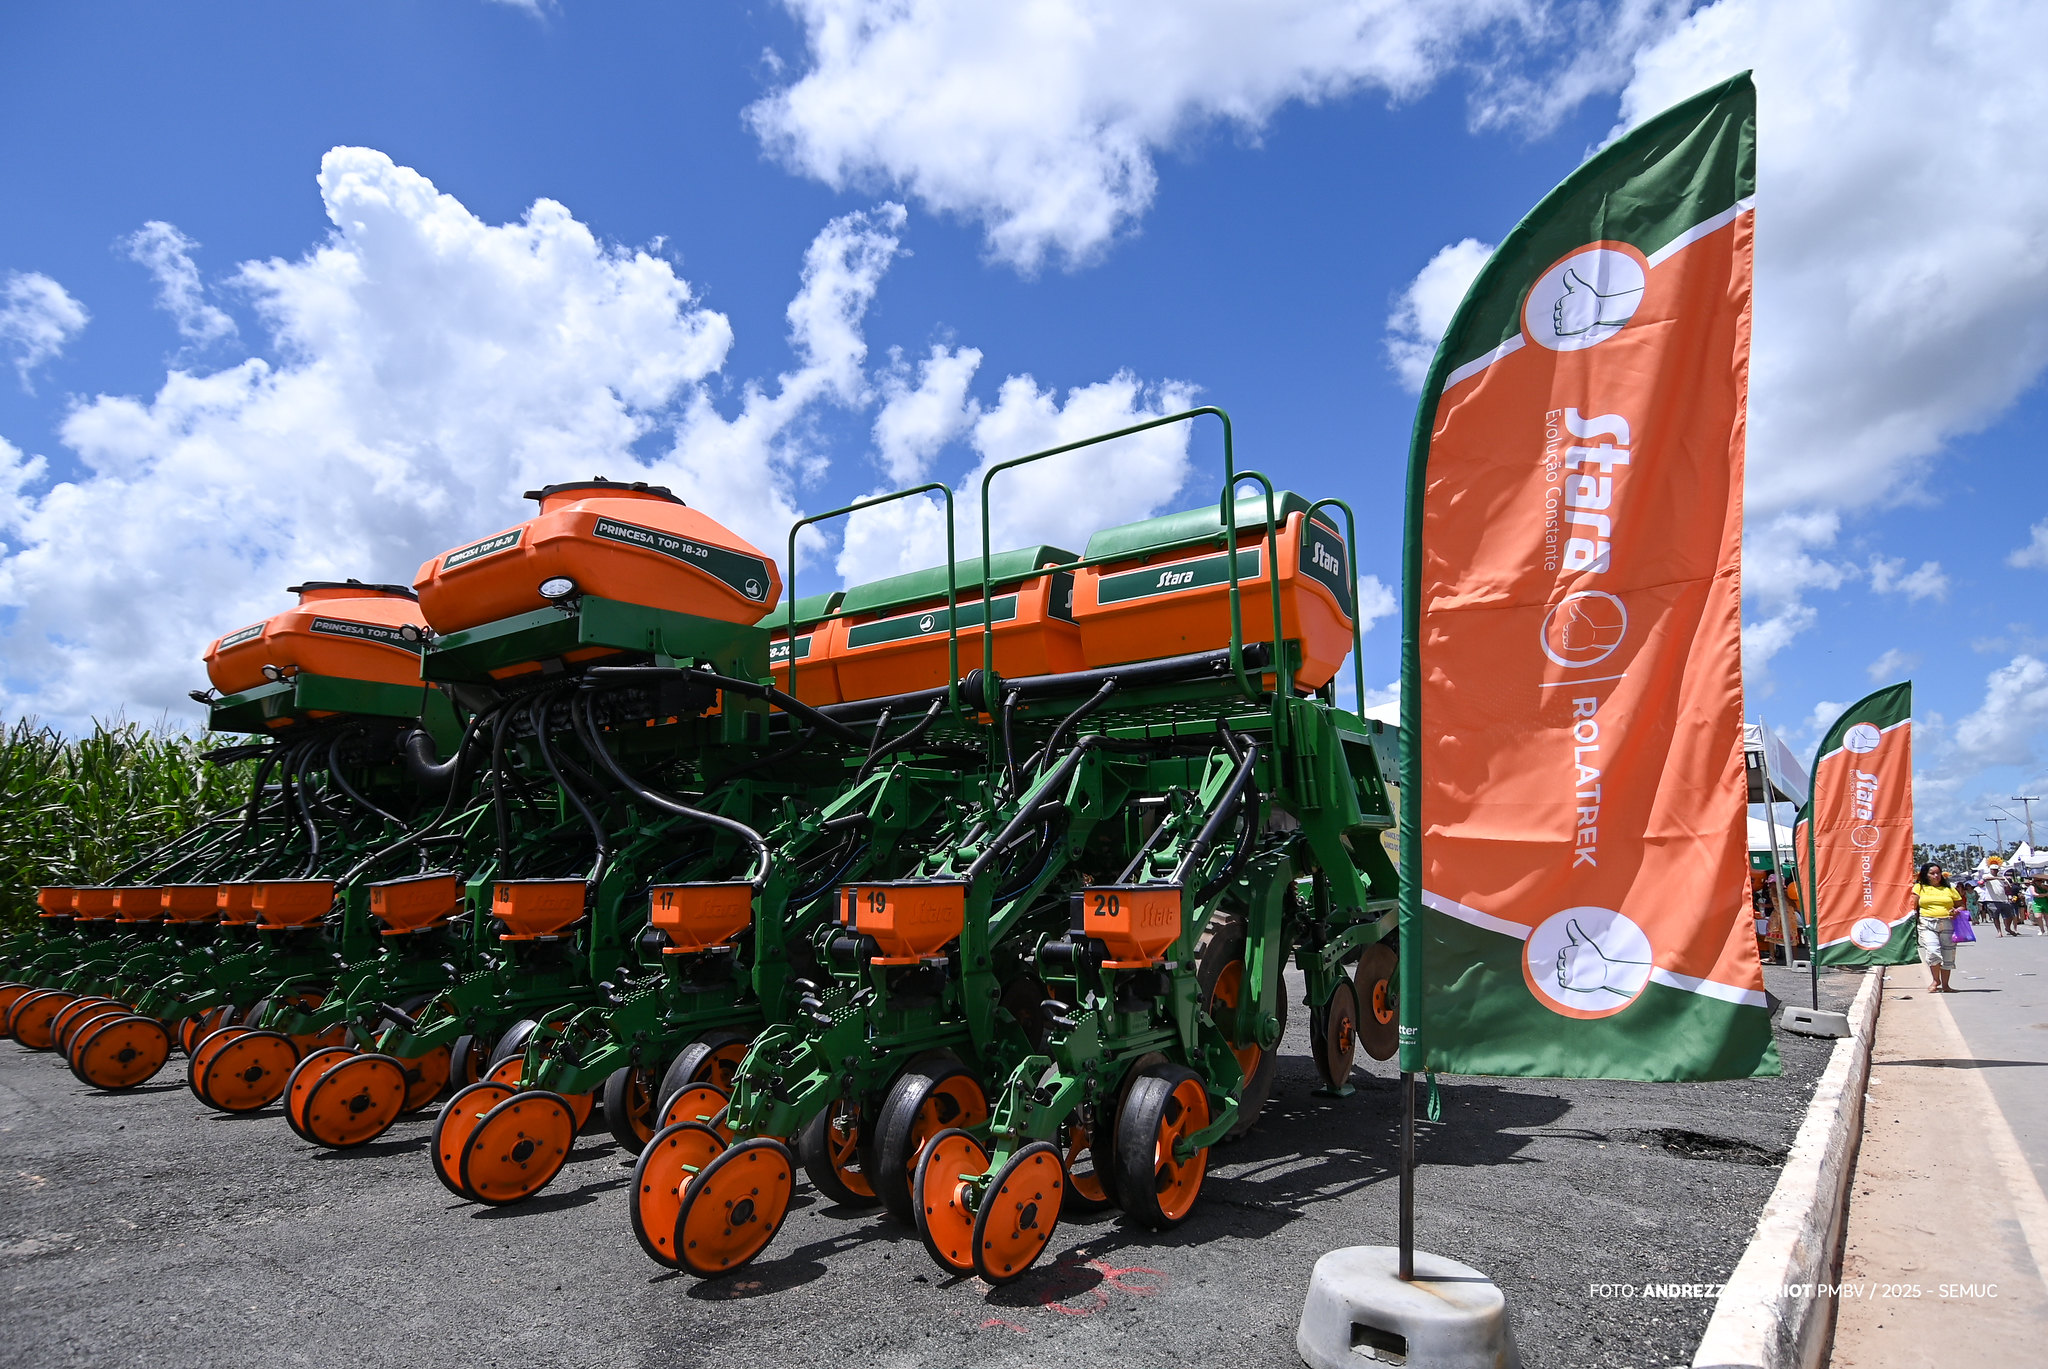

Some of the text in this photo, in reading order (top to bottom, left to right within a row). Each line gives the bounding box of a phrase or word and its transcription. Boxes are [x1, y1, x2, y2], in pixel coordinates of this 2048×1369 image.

[1543, 408, 1562, 571] Evolução Constante
[1562, 407, 1630, 574] Stara
[599, 523, 709, 558] PRINCESA TOP 18-20
[1312, 541, 1339, 576] Stara
[1156, 570, 1195, 588] Stara
[314, 621, 364, 635] PRINCESA
[367, 628, 387, 639] TOP
[1572, 696, 1602, 869] ROLATREK
[1855, 769, 1878, 821] Stara
[499, 887, 510, 903] 15
[1861, 855, 1873, 907] ROLATREK
[660, 891, 674, 910] 17
[867, 891, 886, 913] 19
[1094, 894, 1120, 917] 20
[1140, 901, 1174, 928] Stara
